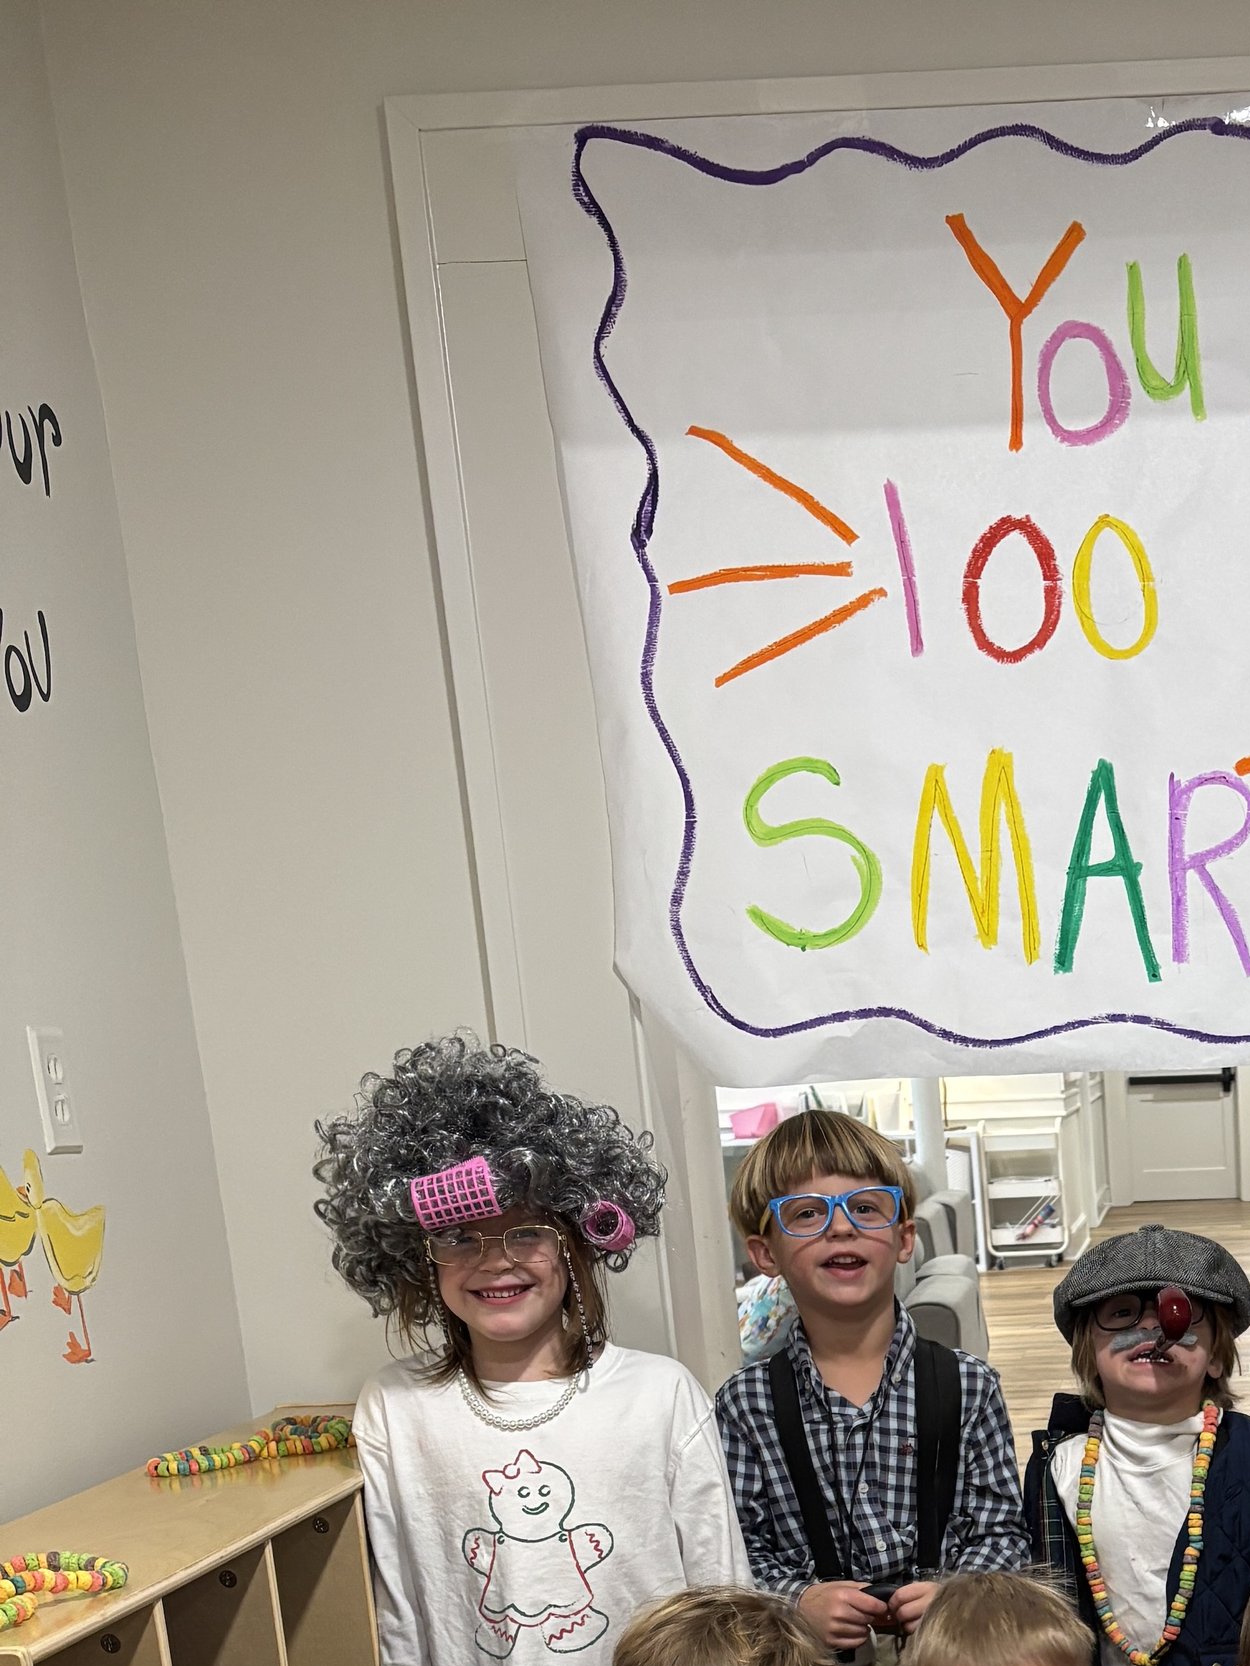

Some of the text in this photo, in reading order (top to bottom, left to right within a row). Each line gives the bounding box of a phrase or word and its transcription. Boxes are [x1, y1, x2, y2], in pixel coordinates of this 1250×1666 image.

[945, 212, 1206, 453] YOU
[0, 403, 62, 498] ur
[884, 478, 1158, 664] 100
[0, 608, 51, 713] ou
